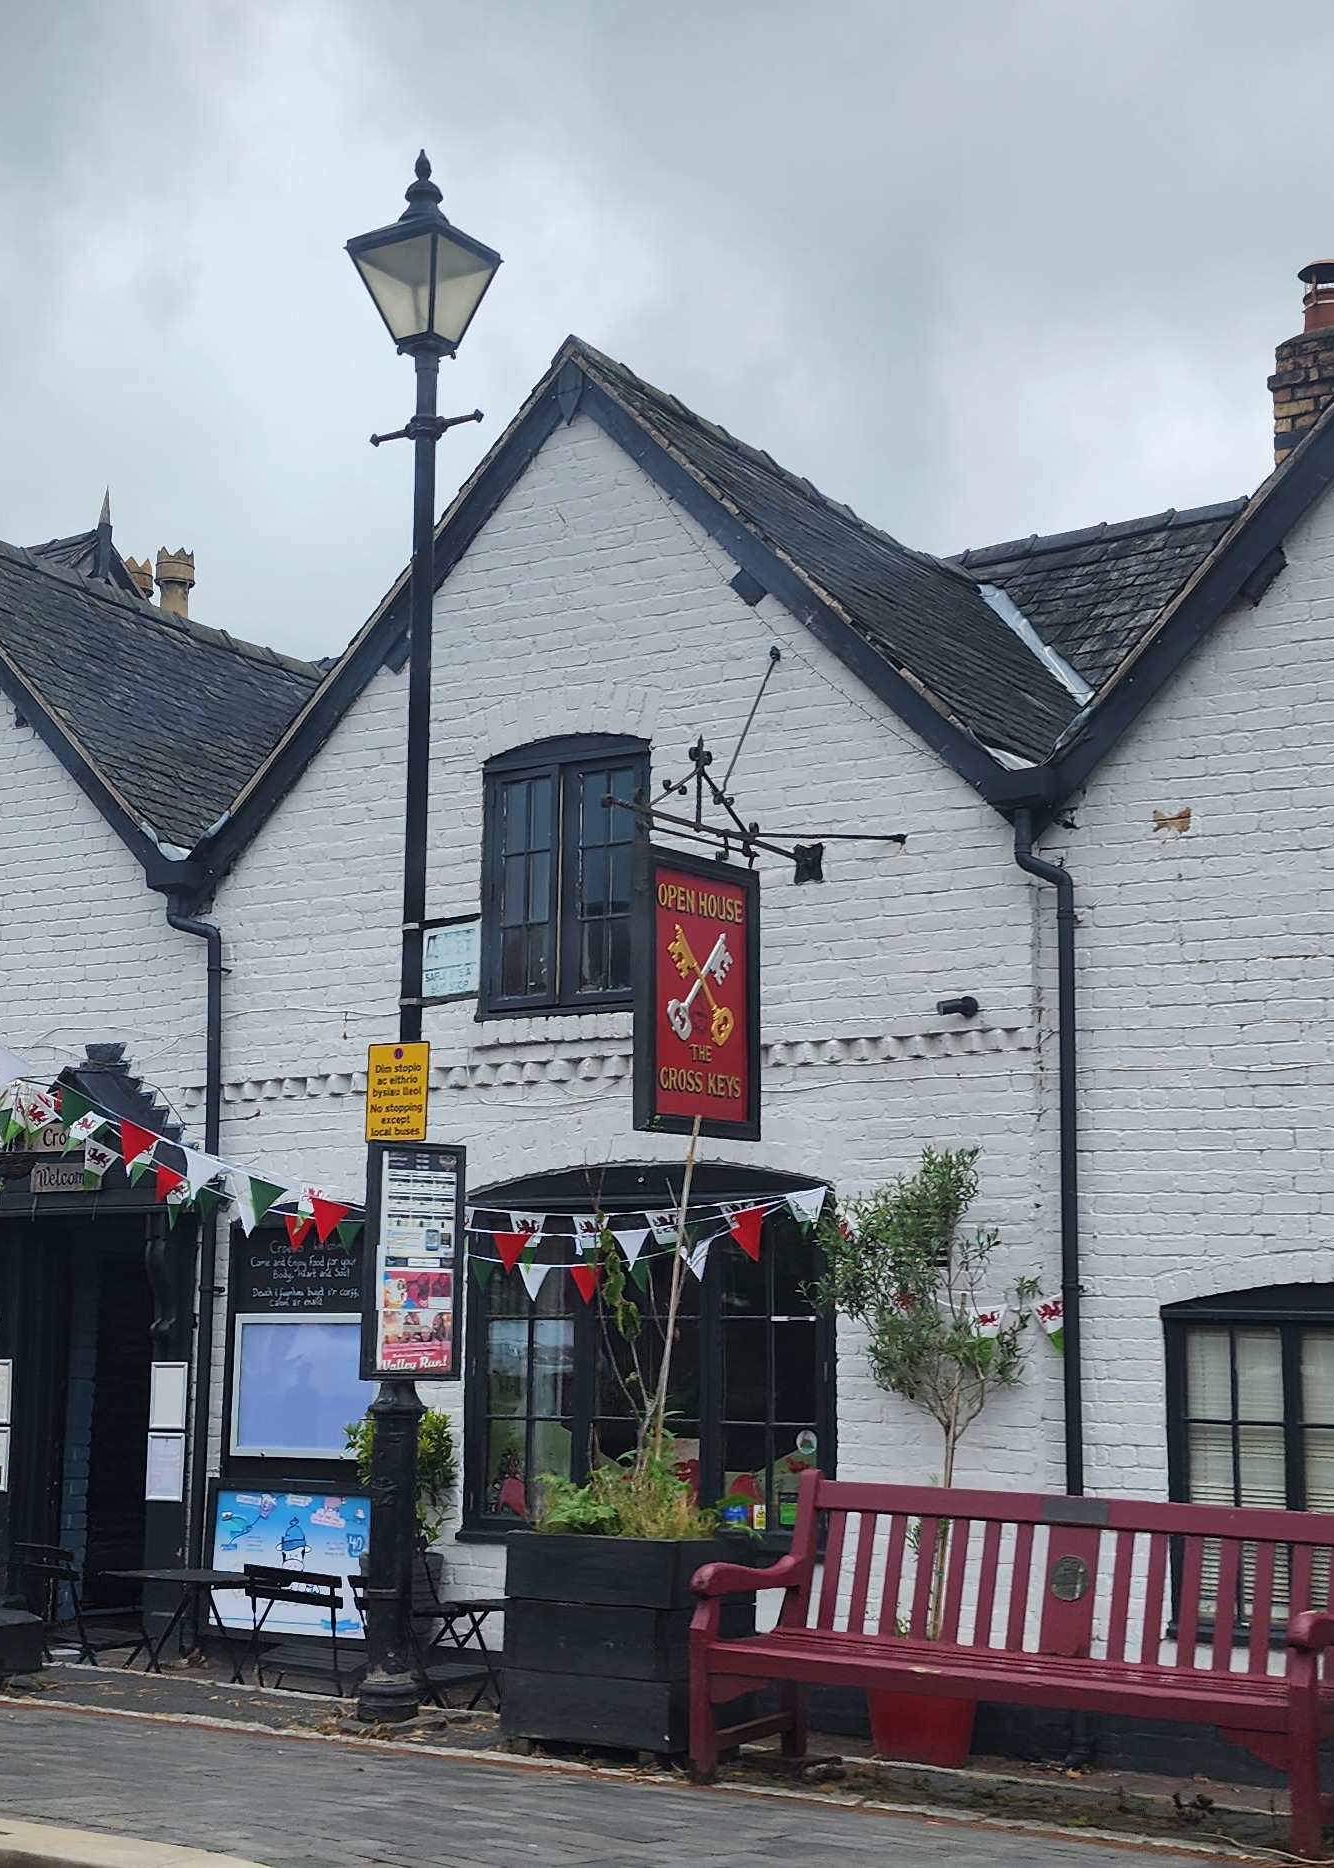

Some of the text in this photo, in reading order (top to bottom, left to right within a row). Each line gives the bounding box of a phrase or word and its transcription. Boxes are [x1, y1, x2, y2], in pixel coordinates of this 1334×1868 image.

[657, 883, 744, 923] OPEN HOUSE
[689, 1043, 712, 1062] THE
[375, 1062, 422, 1074] Dim stopio
[377, 1074, 418, 1085] ac eithrio
[659, 1067, 741, 1098] CROSS KEYS
[372, 1086, 422, 1098] bysiau lleol
[370, 1102, 423, 1114] No stopping
[381, 1114, 411, 1125] except
[371, 1127, 420, 1137] local buses
[35, 1166, 85, 1187] Welcom
[270, 1240, 304, 1254] Croeo
[250, 1256, 271, 1267] Come
[273, 1257, 286, 1267] and
[287, 1256, 307, 1272] Enjoy
[327, 1257, 338, 1270] for
[340, 1259, 356, 1270] your
[298, 1269, 316, 1278] Heart
[319, 1268, 332, 1278] and
[382, 1359, 417, 1370] Valley
[419, 1354, 448, 1369] Run!
